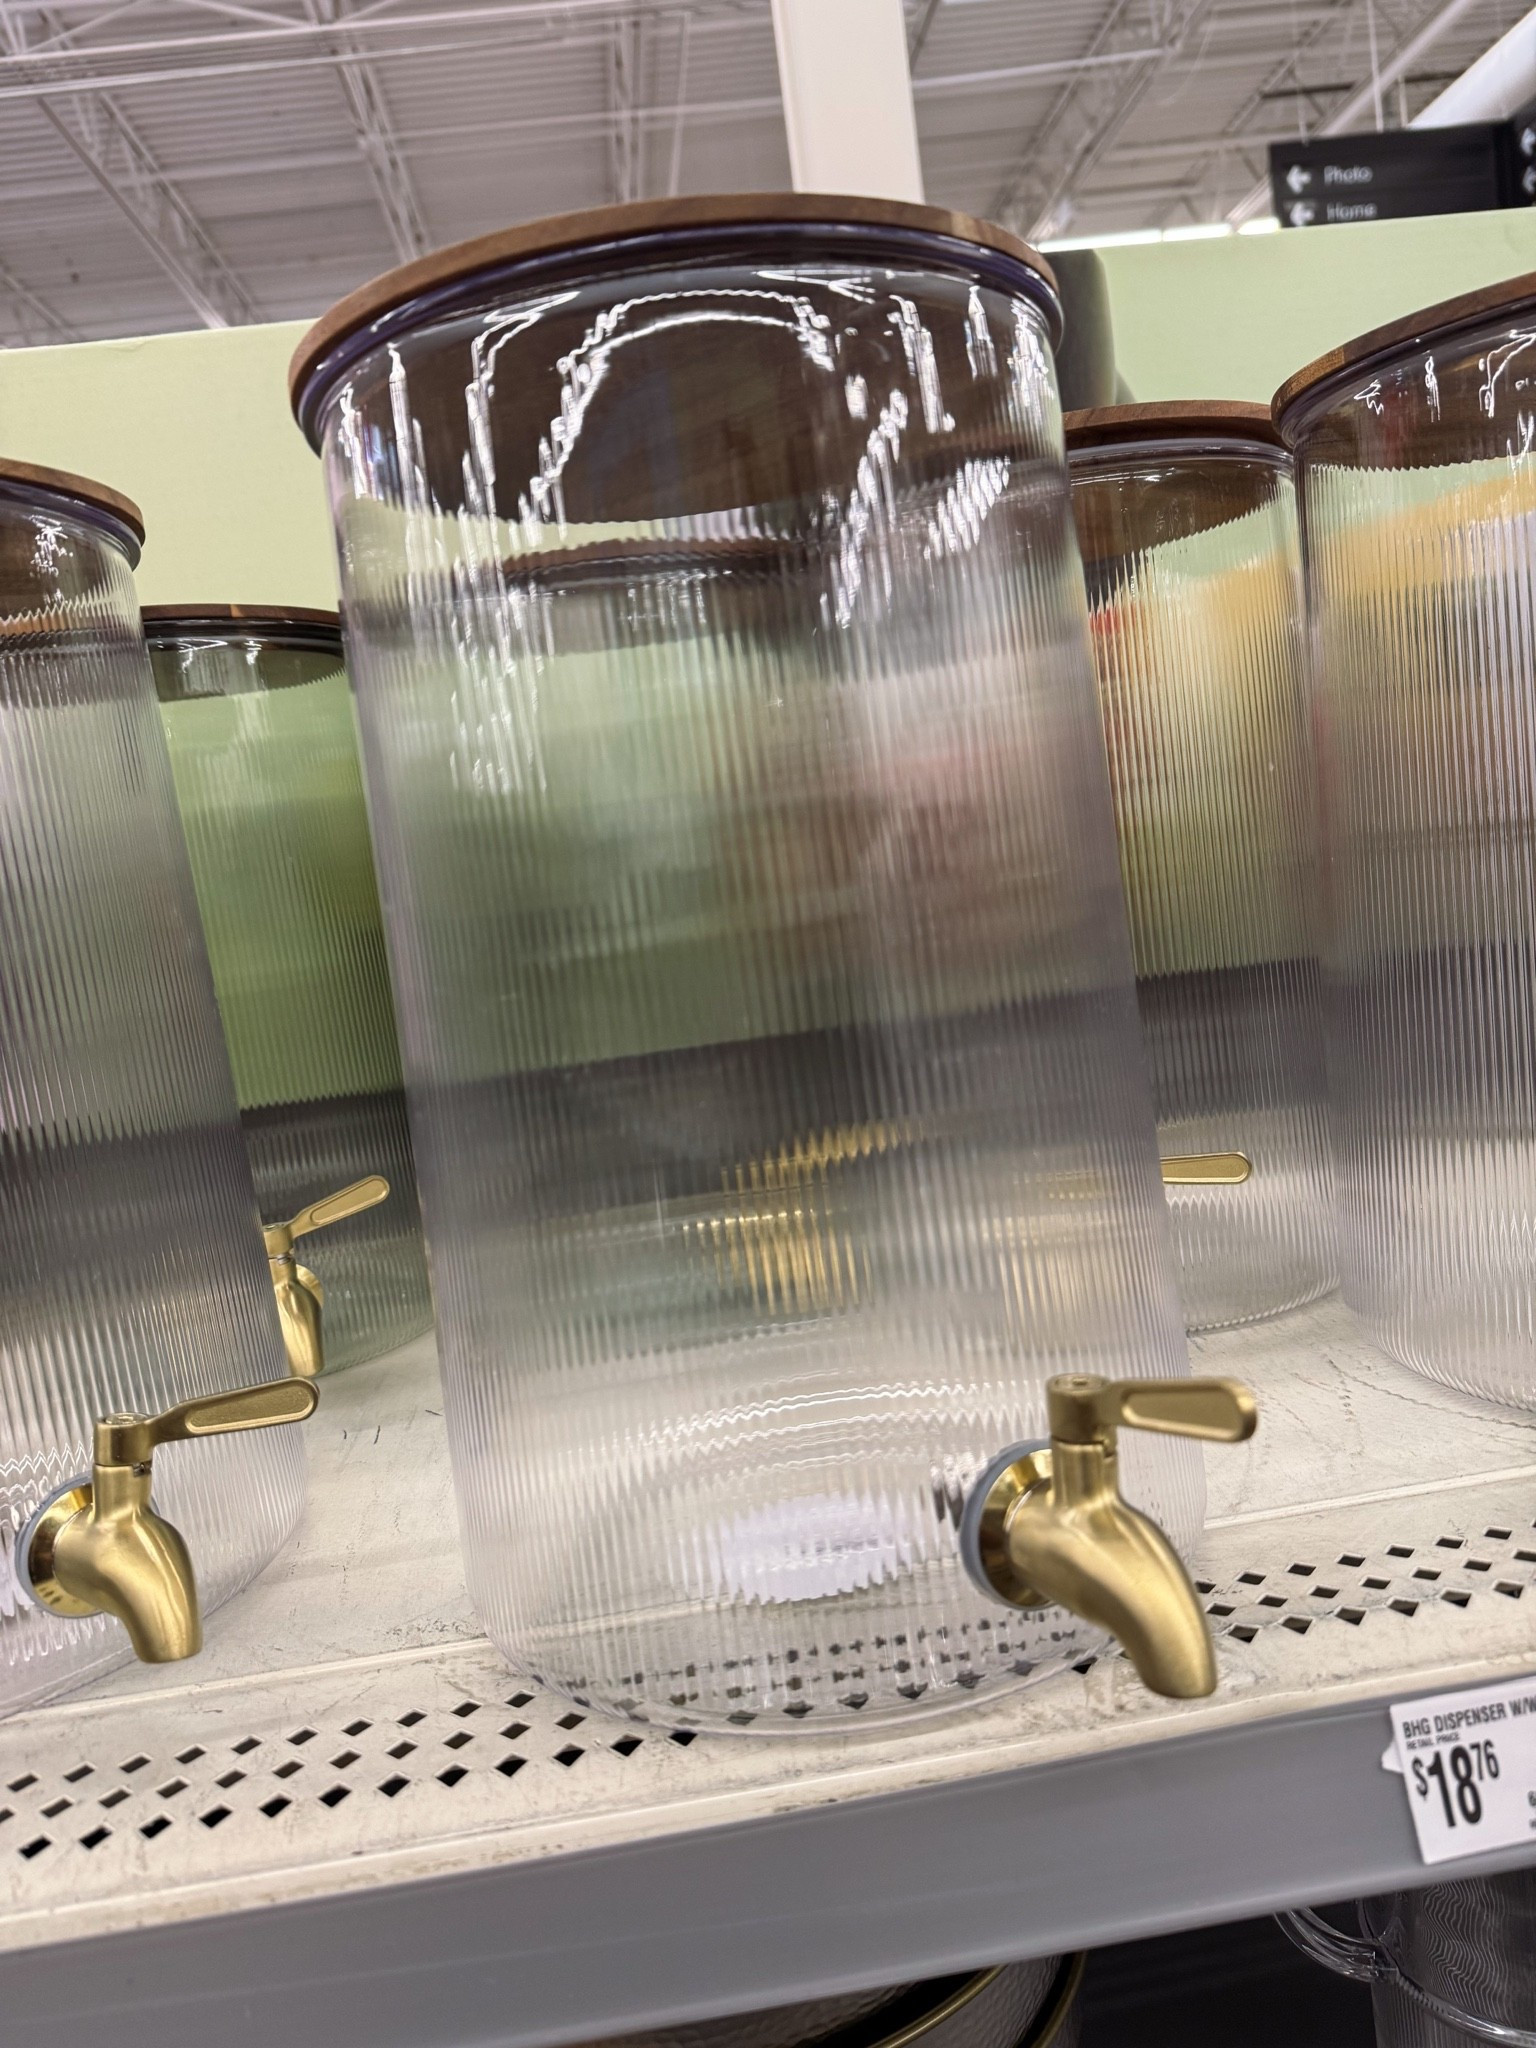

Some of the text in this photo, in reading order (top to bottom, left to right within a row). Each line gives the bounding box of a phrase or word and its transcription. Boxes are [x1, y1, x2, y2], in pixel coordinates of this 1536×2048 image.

[1324, 166, 1373, 184] Photo
[1326, 202, 1377, 221] Home
[1403, 1719, 1431, 1738] BHG
[1434, 1702, 1506, 1732] DISPENSER
[1407, 1732, 1460, 1750] RETAIL PRICE
